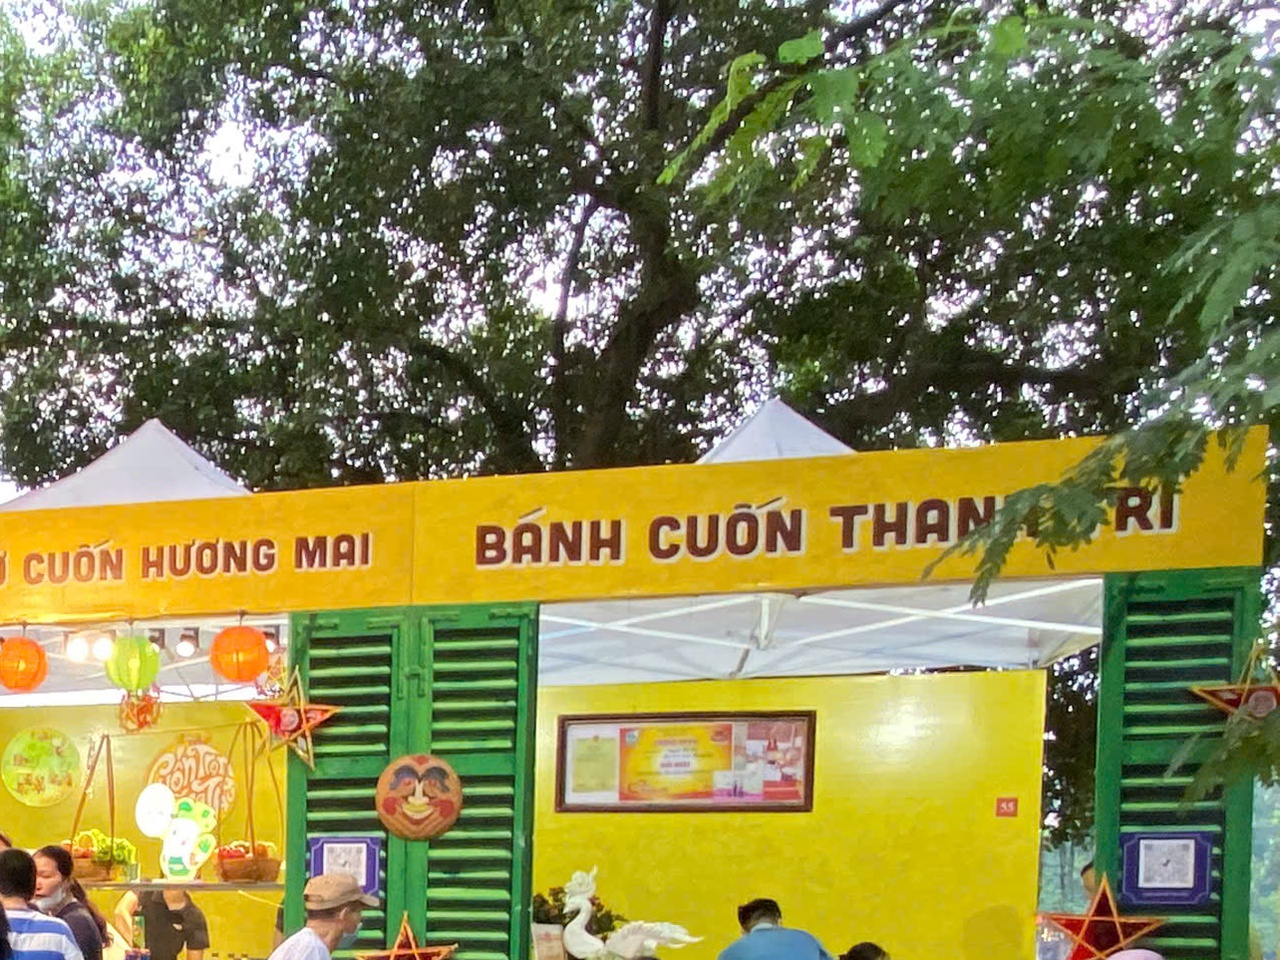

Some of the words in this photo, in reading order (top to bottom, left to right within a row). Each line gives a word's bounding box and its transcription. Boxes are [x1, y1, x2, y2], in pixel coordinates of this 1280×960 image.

[23, 539, 124, 586] CUỐN
[141, 538, 276, 580] HƯƠNG
[294, 532, 370, 569] MAI
[475, 507, 623, 566] BÁNH
[648, 496, 804, 560] CUỐN
[829, 495, 1038, 550] THAN
